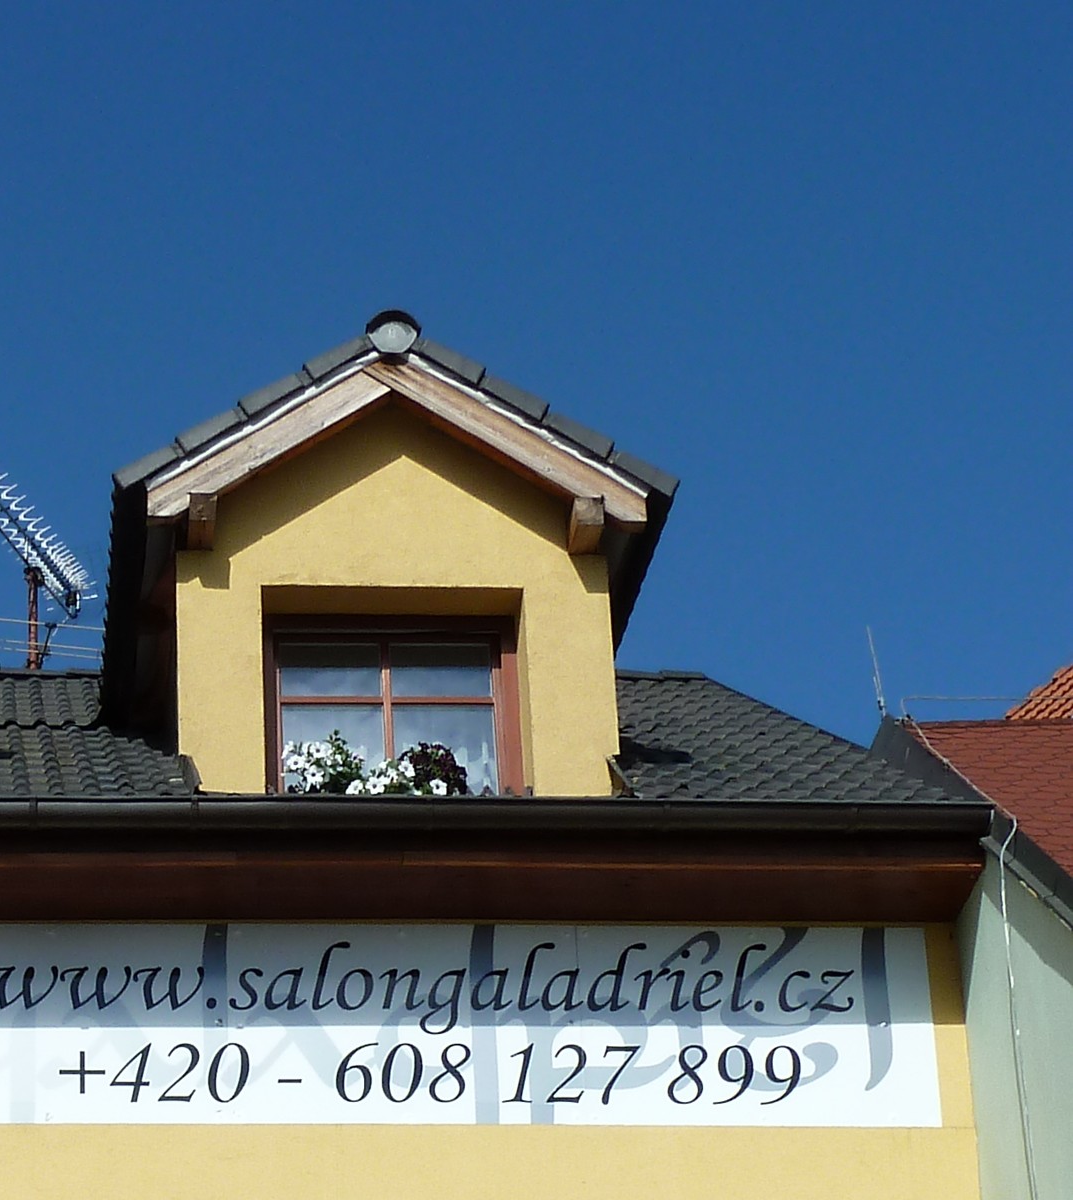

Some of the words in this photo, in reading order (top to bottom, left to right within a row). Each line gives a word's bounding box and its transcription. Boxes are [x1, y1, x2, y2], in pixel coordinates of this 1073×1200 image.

[59, 1042, 251, 1103] +420
[334, 1042, 473, 1104] 608
[501, 1042, 642, 1105] 127
[666, 1044, 803, 1105] 899
